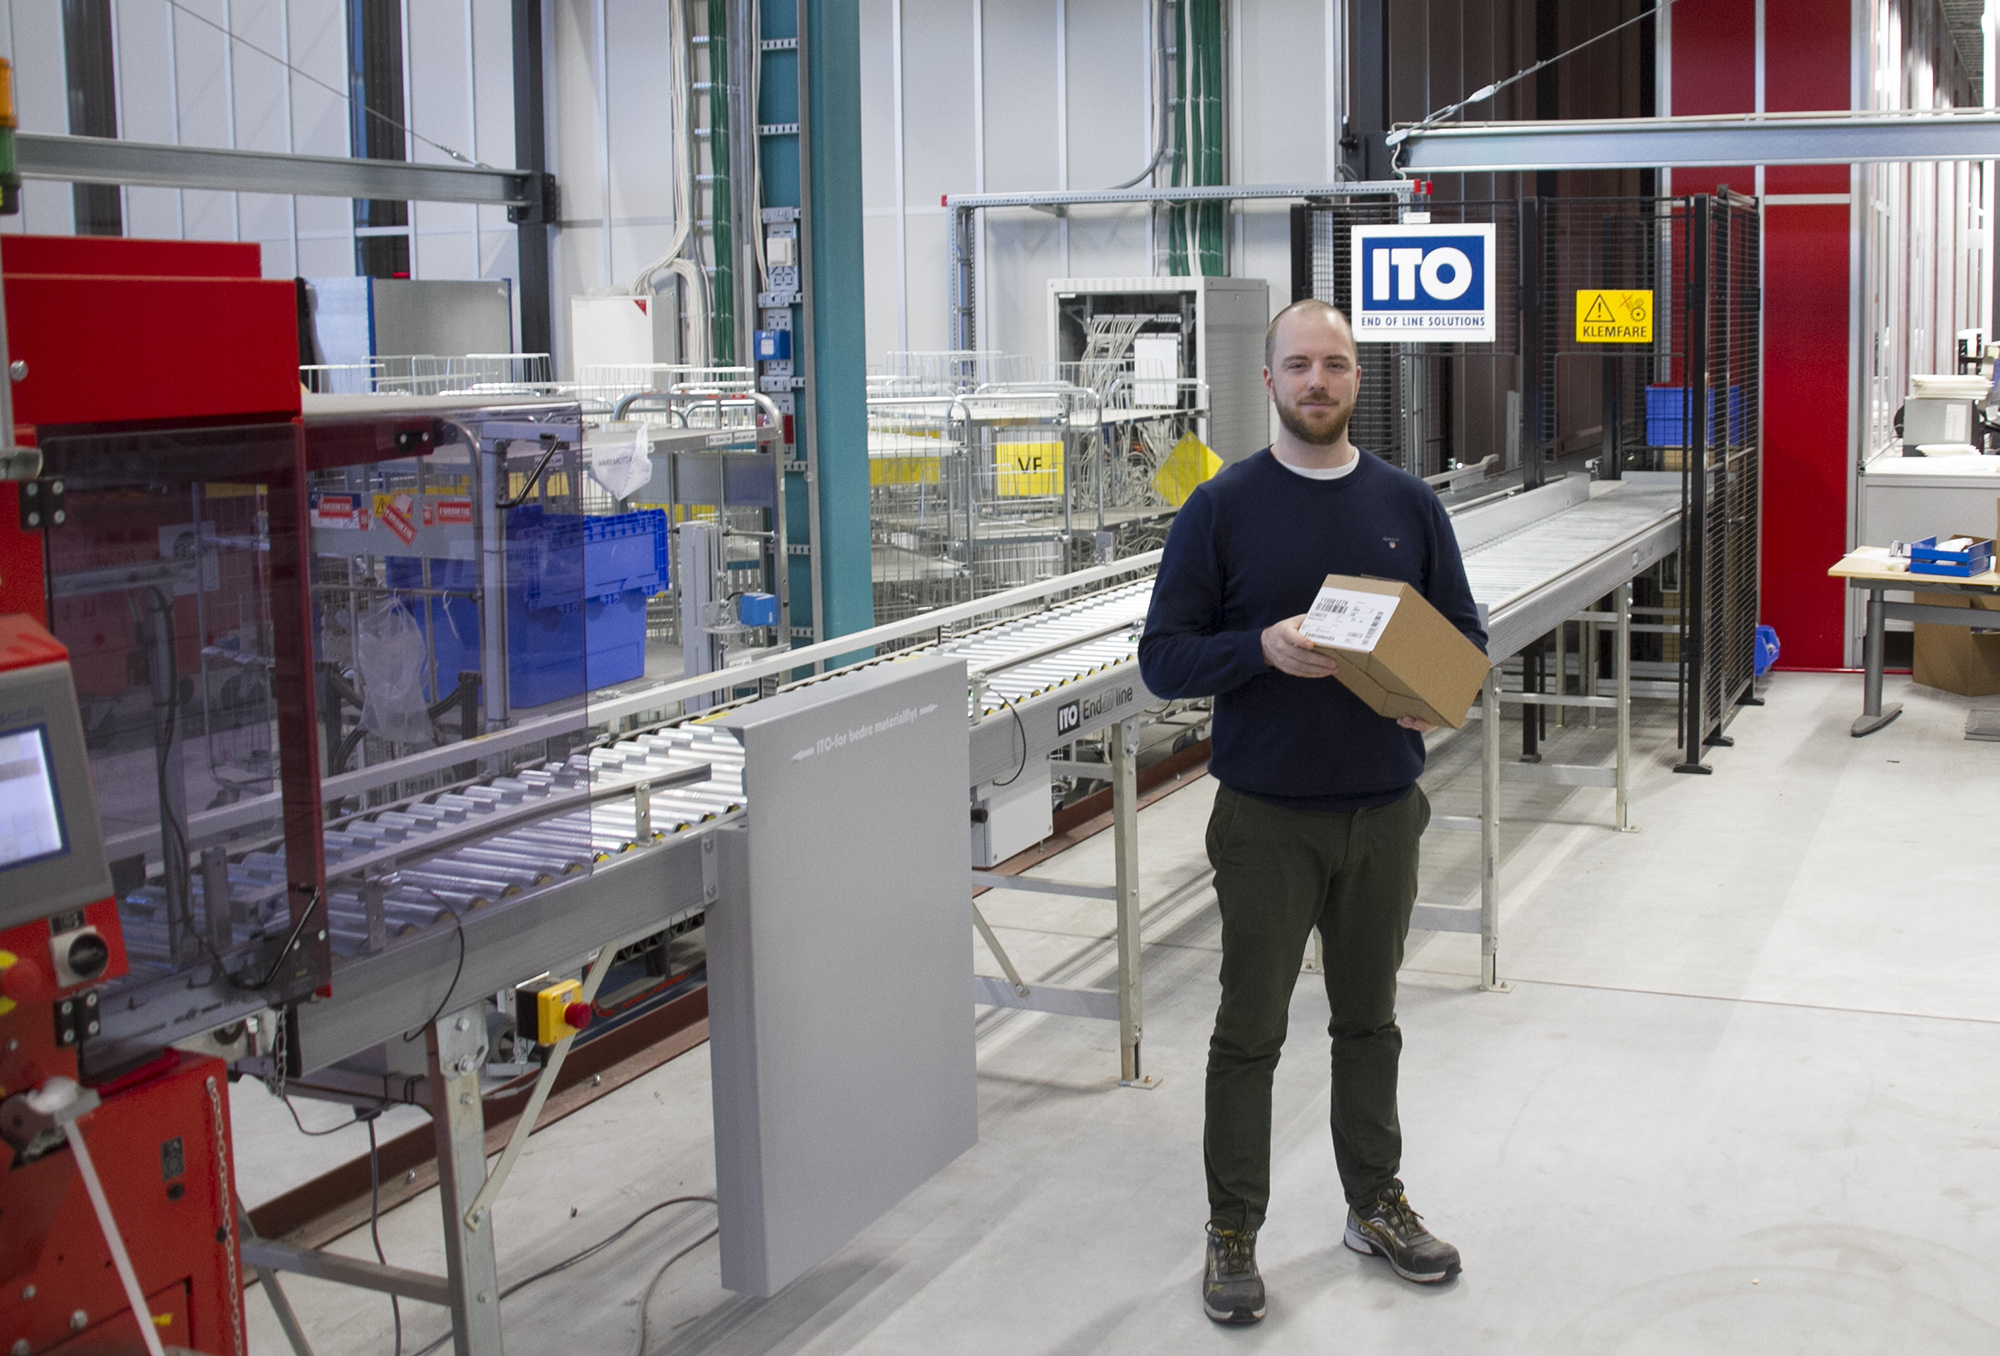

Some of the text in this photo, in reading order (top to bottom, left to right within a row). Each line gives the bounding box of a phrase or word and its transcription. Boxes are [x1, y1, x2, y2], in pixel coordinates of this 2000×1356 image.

[1372, 246, 1473, 301] ITO
[1361, 316, 1485, 327] END OF LINE SOLUTIONS
[1583, 326, 1647, 338] KLEMFARE
[1018, 456, 1042, 475] VF
[1059, 704, 1078, 732] ITO
[1083, 693, 1103, 720] End
[1115, 686, 1133, 707] line
[816, 706, 918, 755] ITO-for bedre materialflyt
